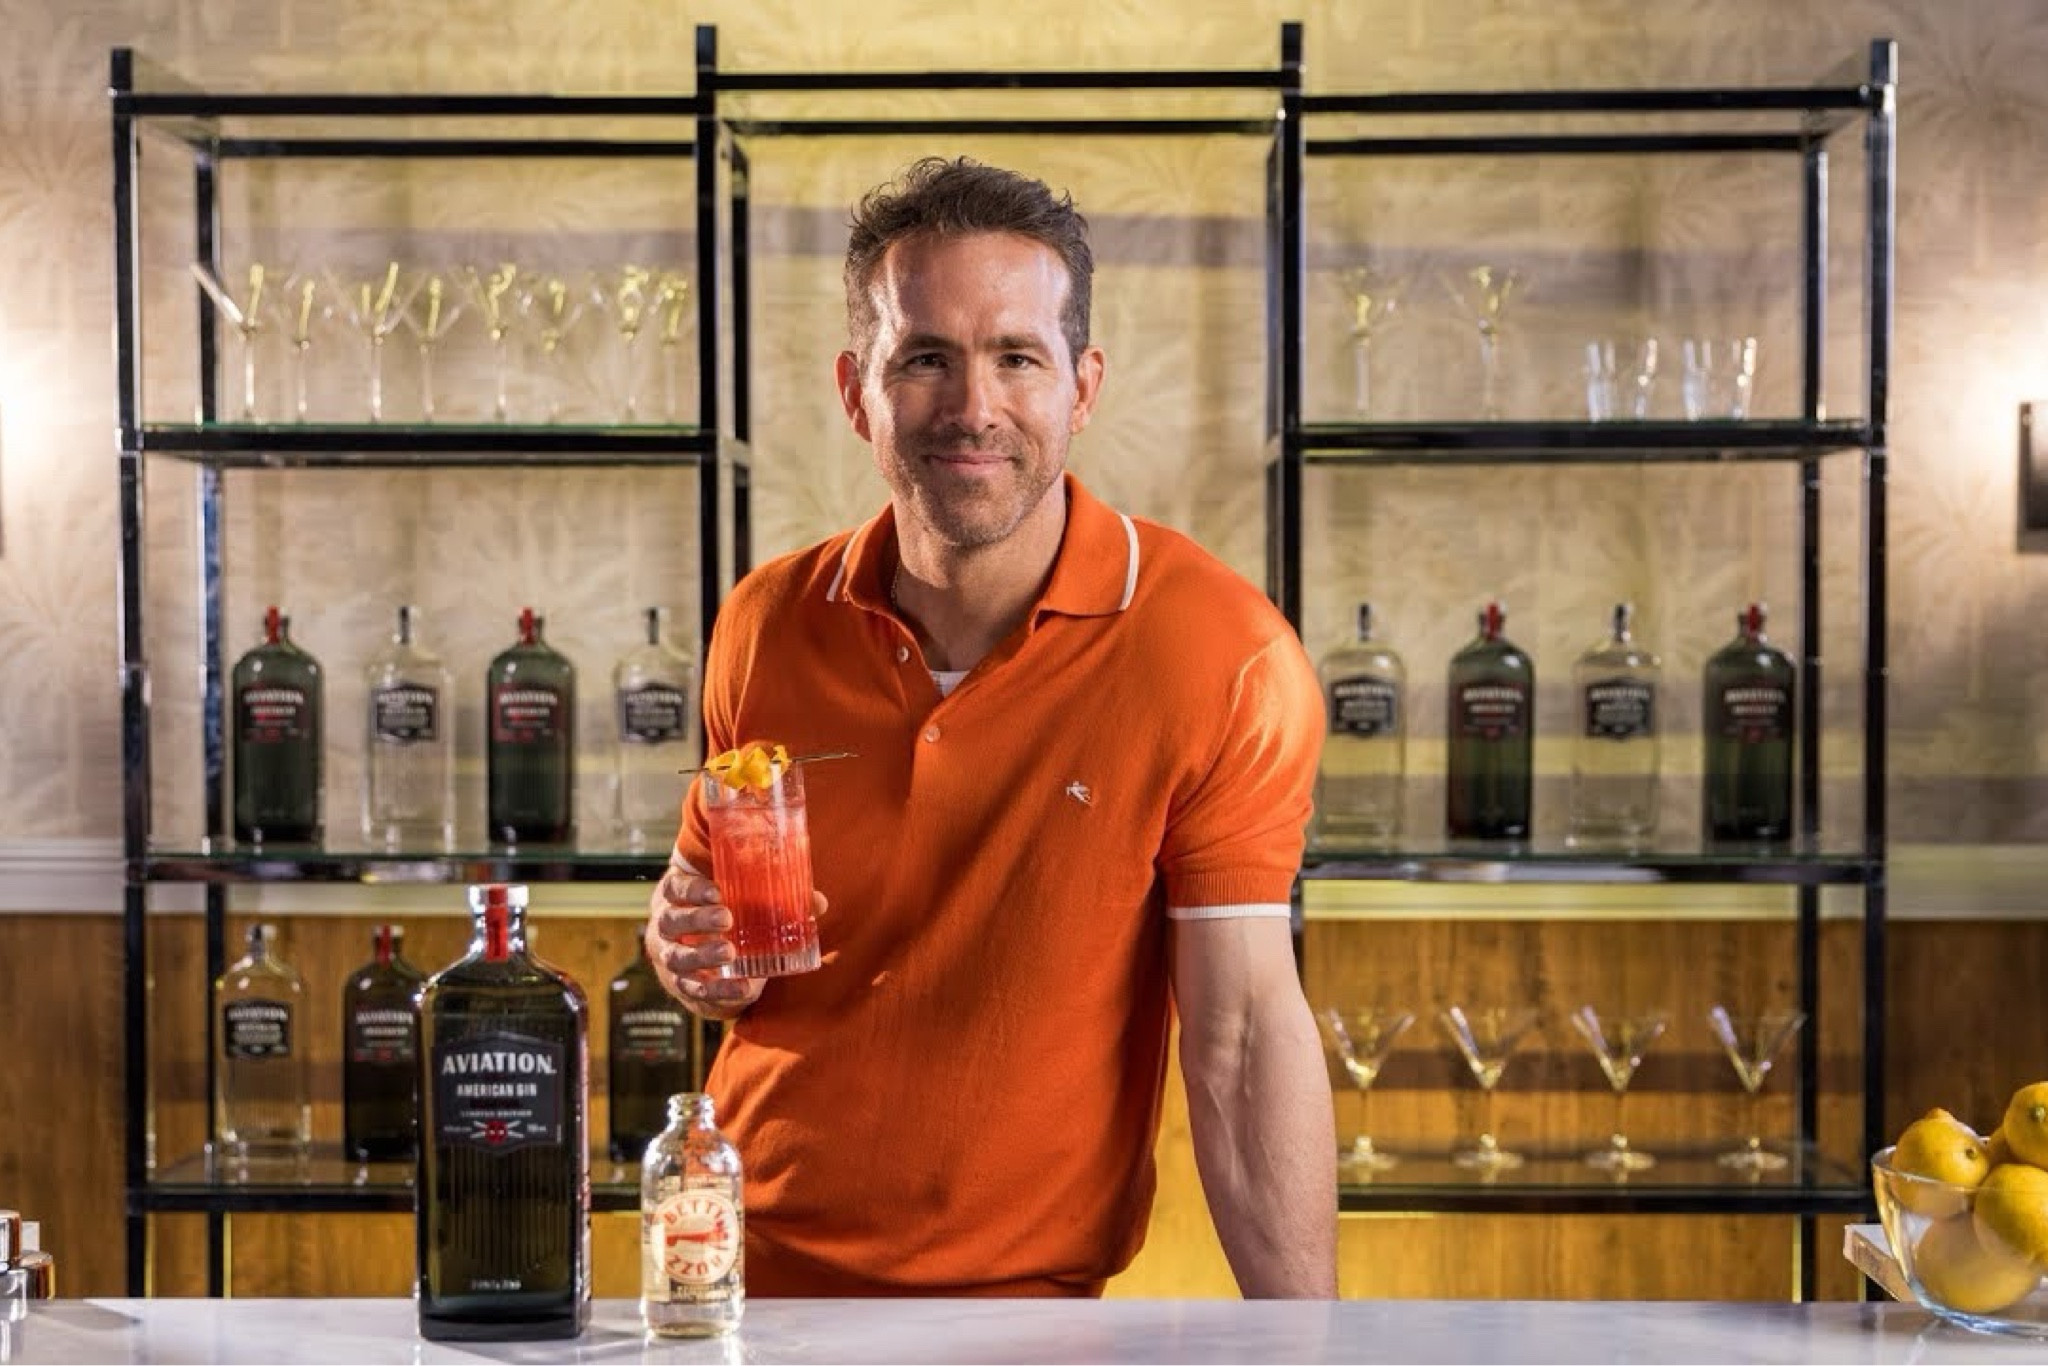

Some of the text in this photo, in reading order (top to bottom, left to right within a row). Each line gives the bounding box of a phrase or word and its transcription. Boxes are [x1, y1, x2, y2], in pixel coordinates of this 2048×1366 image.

[456, 1083, 537, 1097] AMERICAN GIN
[664, 1199, 724, 1225] BETTY
